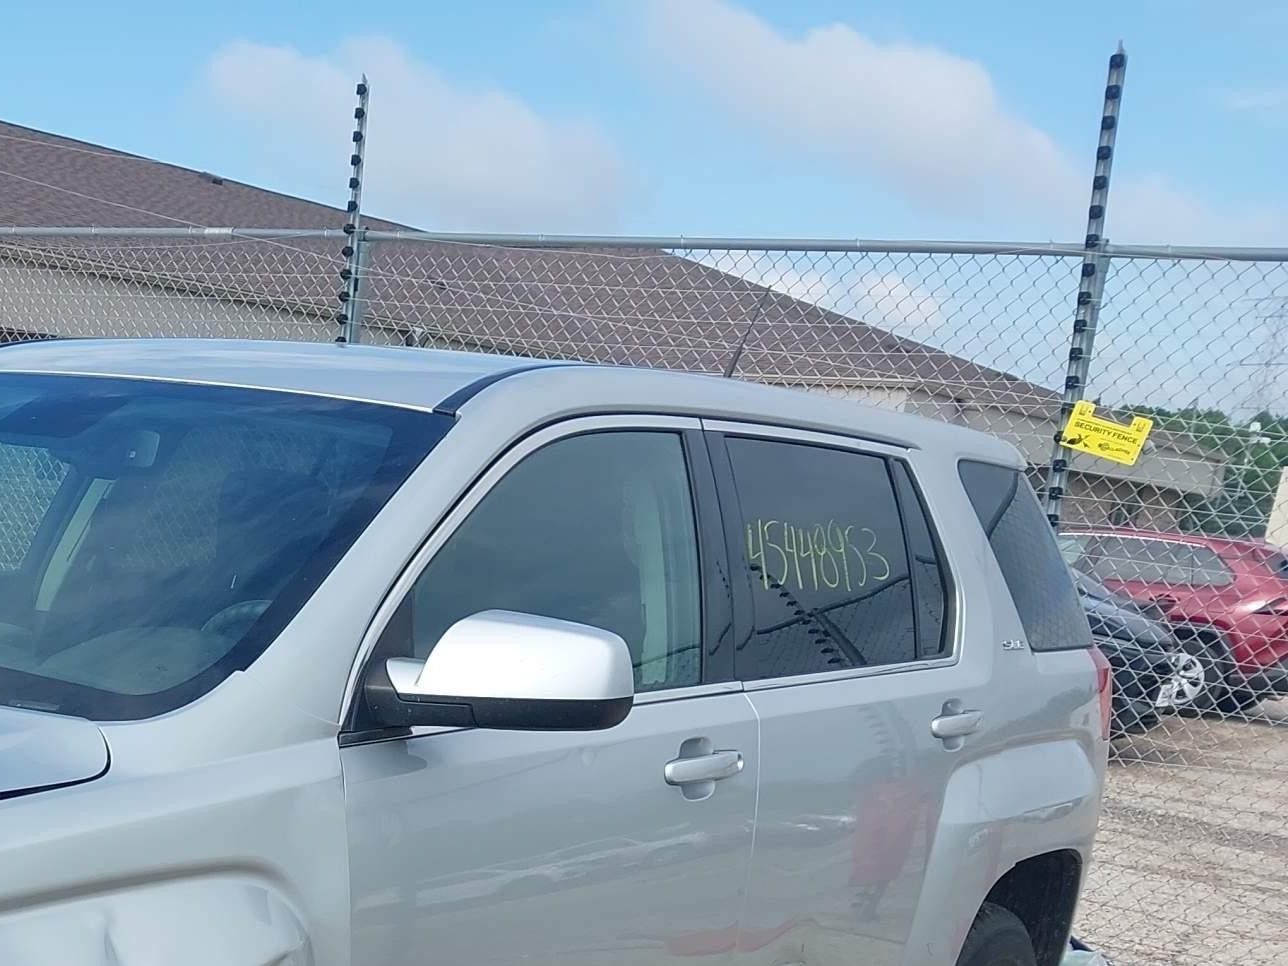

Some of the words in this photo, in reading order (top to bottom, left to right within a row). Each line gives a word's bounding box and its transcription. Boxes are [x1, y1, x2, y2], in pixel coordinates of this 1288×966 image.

[1074, 421, 1112, 436] SECURITY
[1112, 432, 1138, 445] FENCE
[747, 519, 889, 592] 45448953
